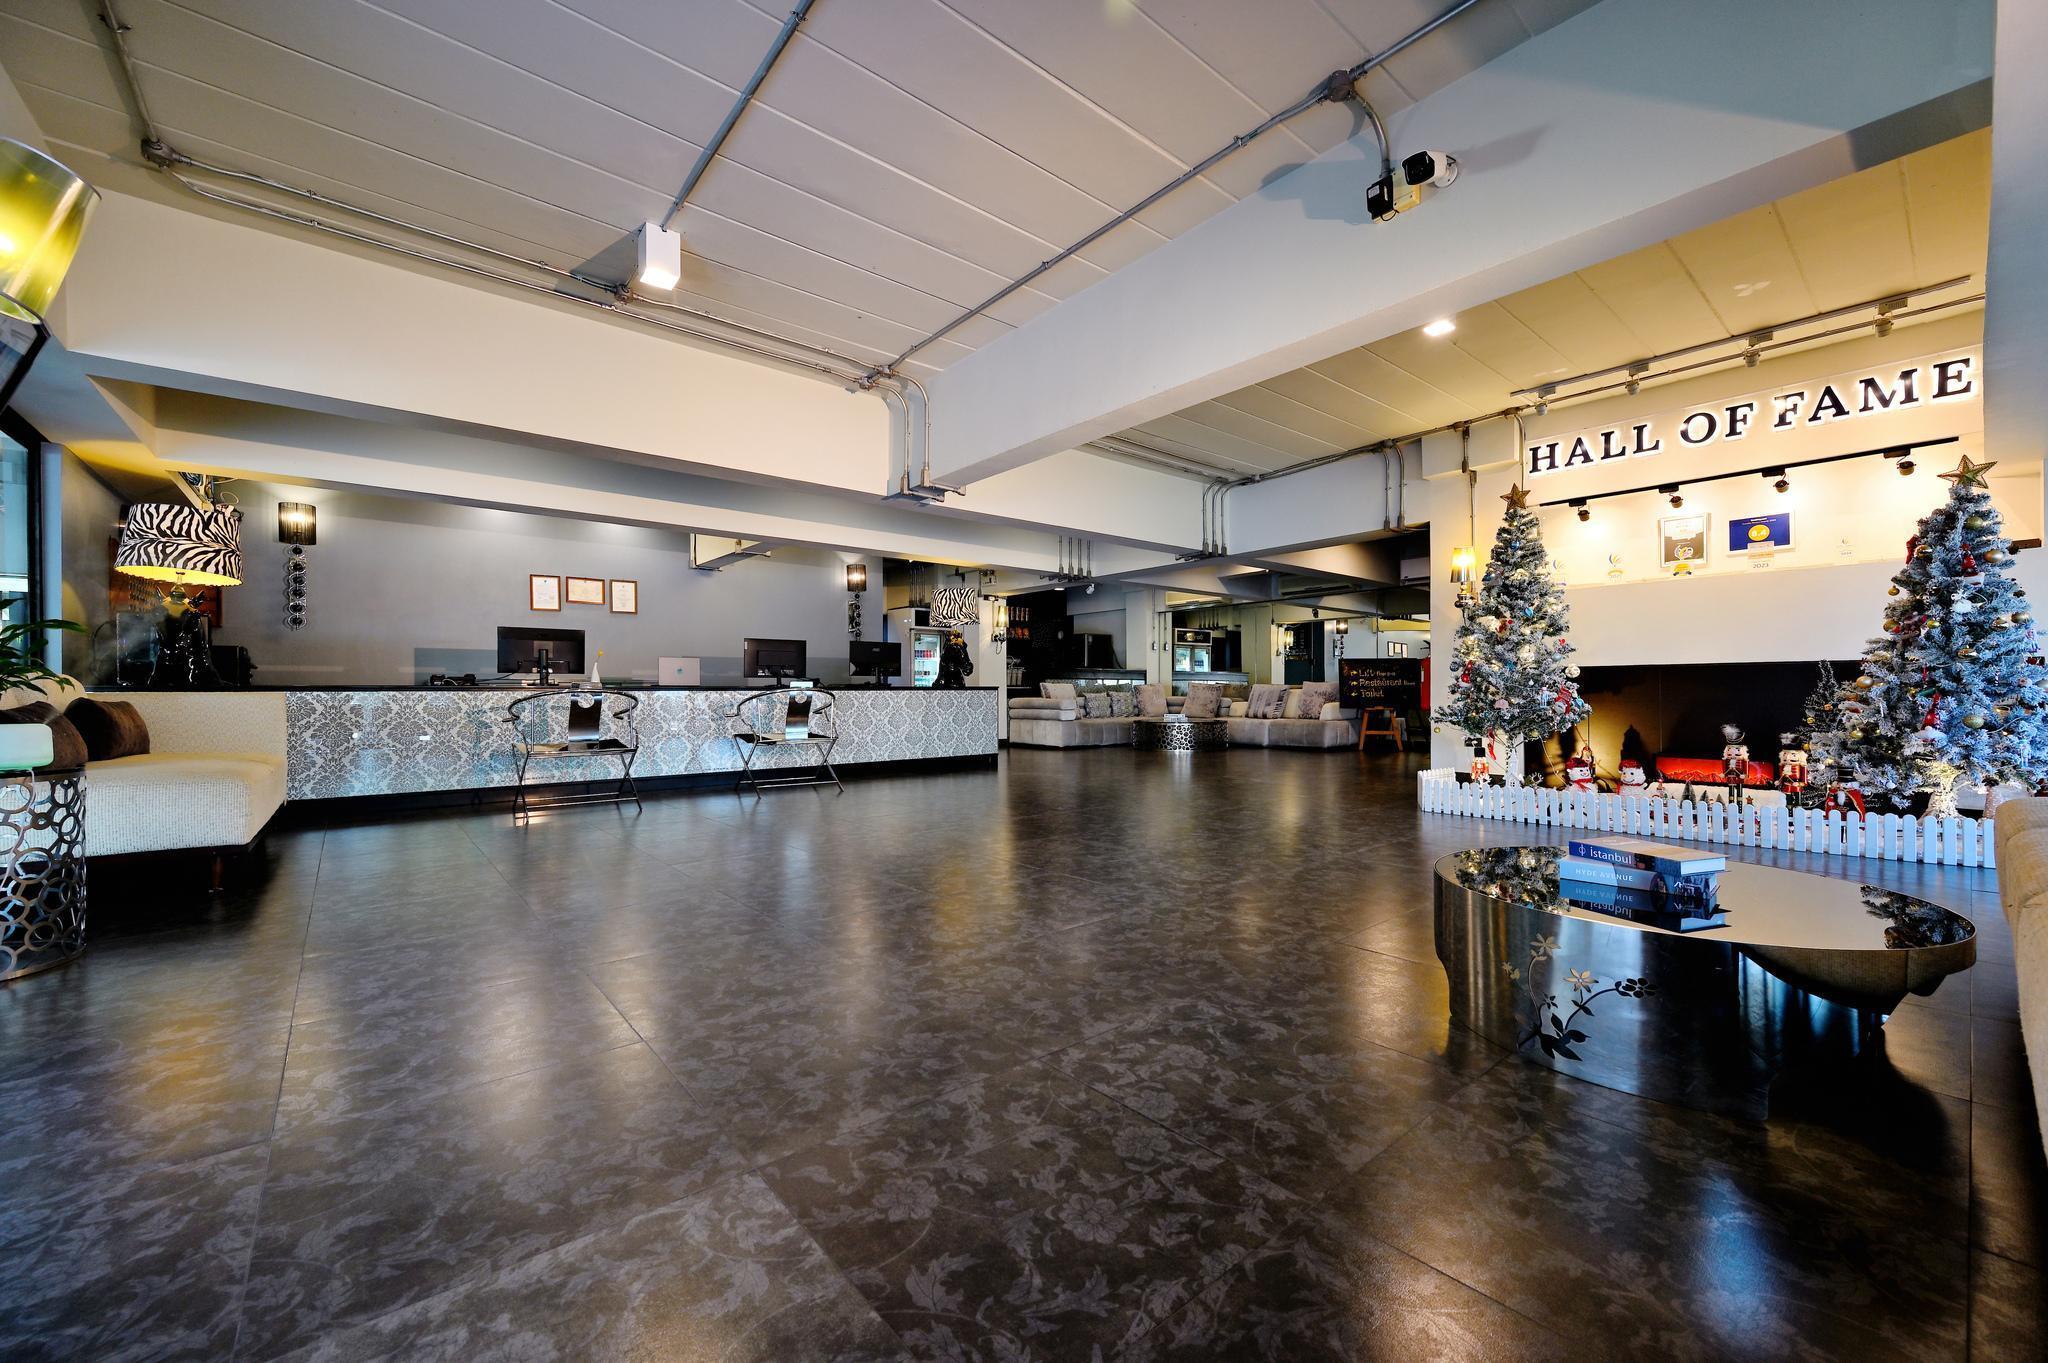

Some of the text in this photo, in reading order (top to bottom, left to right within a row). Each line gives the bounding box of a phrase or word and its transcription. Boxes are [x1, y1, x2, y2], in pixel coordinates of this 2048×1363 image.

[1529, 357, 1972, 475] HALL OF FAME
[1359, 678, 1402, 687] Restaurant
